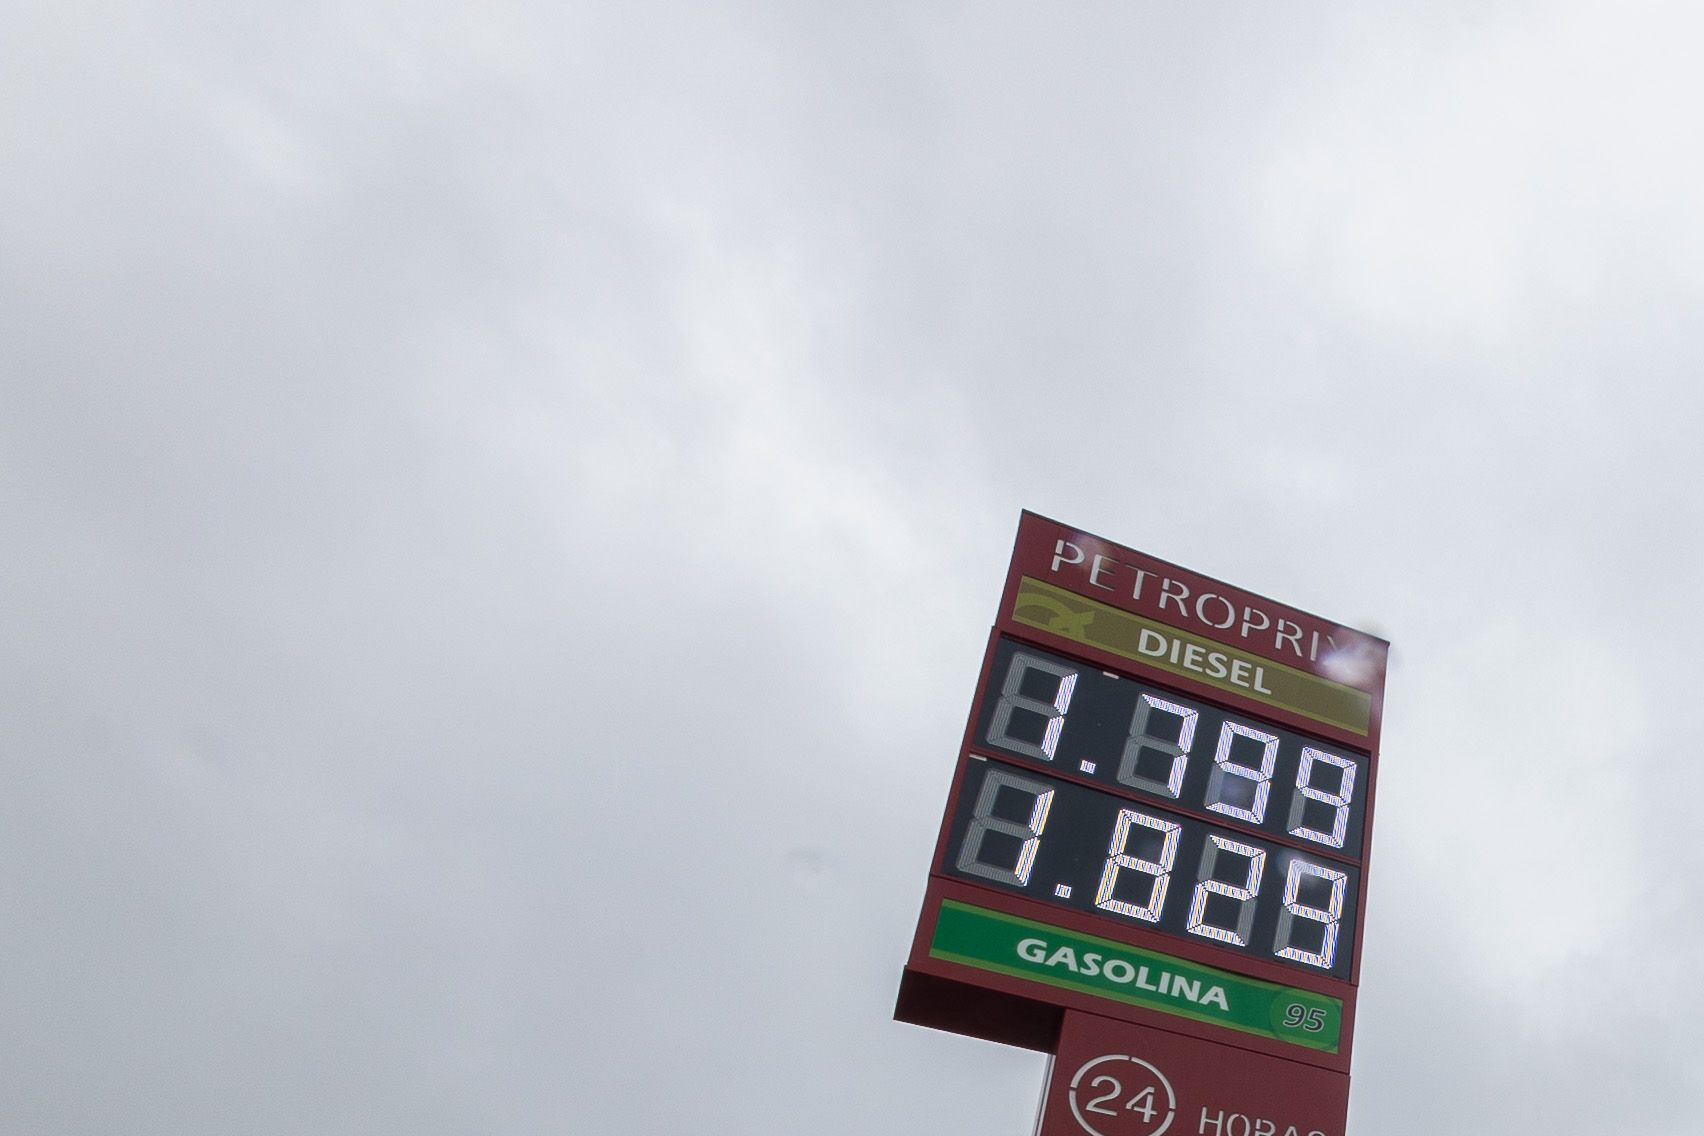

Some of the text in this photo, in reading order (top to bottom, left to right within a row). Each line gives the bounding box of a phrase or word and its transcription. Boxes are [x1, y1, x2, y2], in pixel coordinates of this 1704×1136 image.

[1051, 538, 1346, 673] PETROPRI
[1137, 627, 1272, 696] DIESEL
[1040, 671, 1358, 849] 1.799
[1013, 788, 1348, 969] 1.829
[1016, 937, 1327, 1033] GASOLINA 95
[1085, 1074, 1158, 1123] 24
